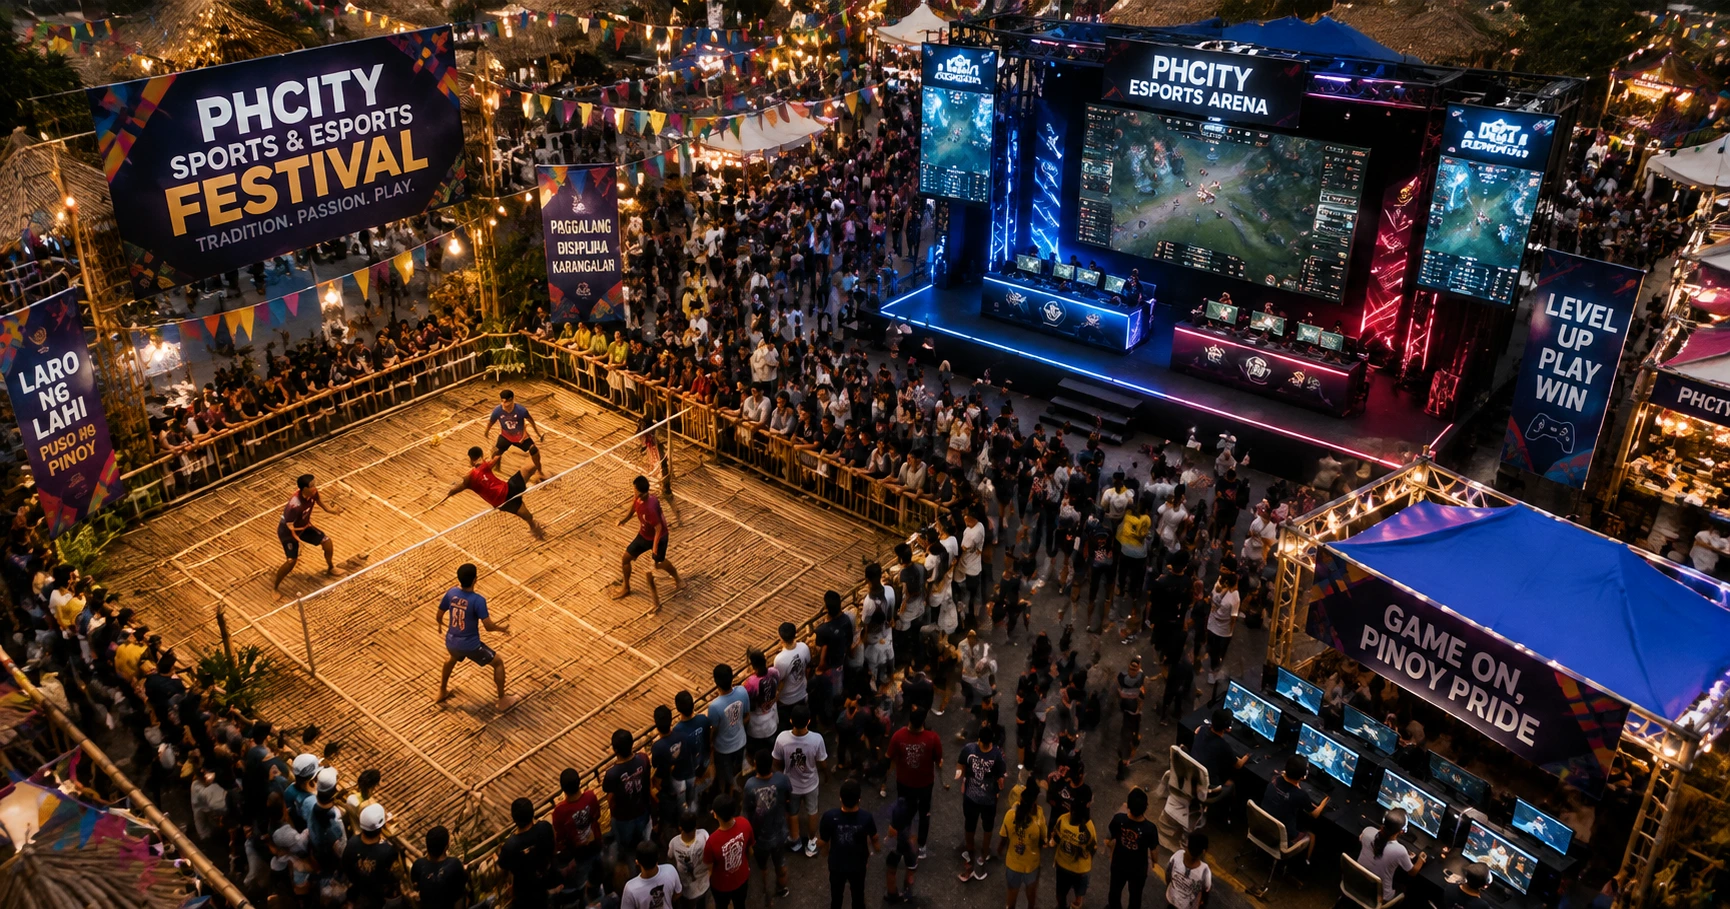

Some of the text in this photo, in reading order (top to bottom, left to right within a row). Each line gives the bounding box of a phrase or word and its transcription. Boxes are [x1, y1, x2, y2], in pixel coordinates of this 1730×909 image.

[1152, 55, 1253, 92] PHCITY
[196, 63, 384, 143] PHCITY
[1129, 79, 1269, 115] ESPORTS ARENA
[170, 103, 414, 180] SPORTS & ESPORTS
[165, 129, 429, 237] FESTIVAL
[195, 178, 415, 252] TRADITION. PASSION. PLAY.
[550, 218, 612, 235] PAGGALANG
[1545, 292, 1618, 334] LEVEL
[1557, 323, 1594, 352] UP
[18, 351, 80, 395] LARO
[1538, 347, 1603, 385] PLAY
[38, 381, 70, 412] NG
[1536, 374, 1588, 412] WIN
[32, 395, 88, 441] LAHI
[39, 432, 77, 462] PUSO
[48, 439, 96, 477] PINOY
[1384, 604, 1524, 705] GAME ON,
[1359, 624, 1541, 747] PINOY PRIDE
